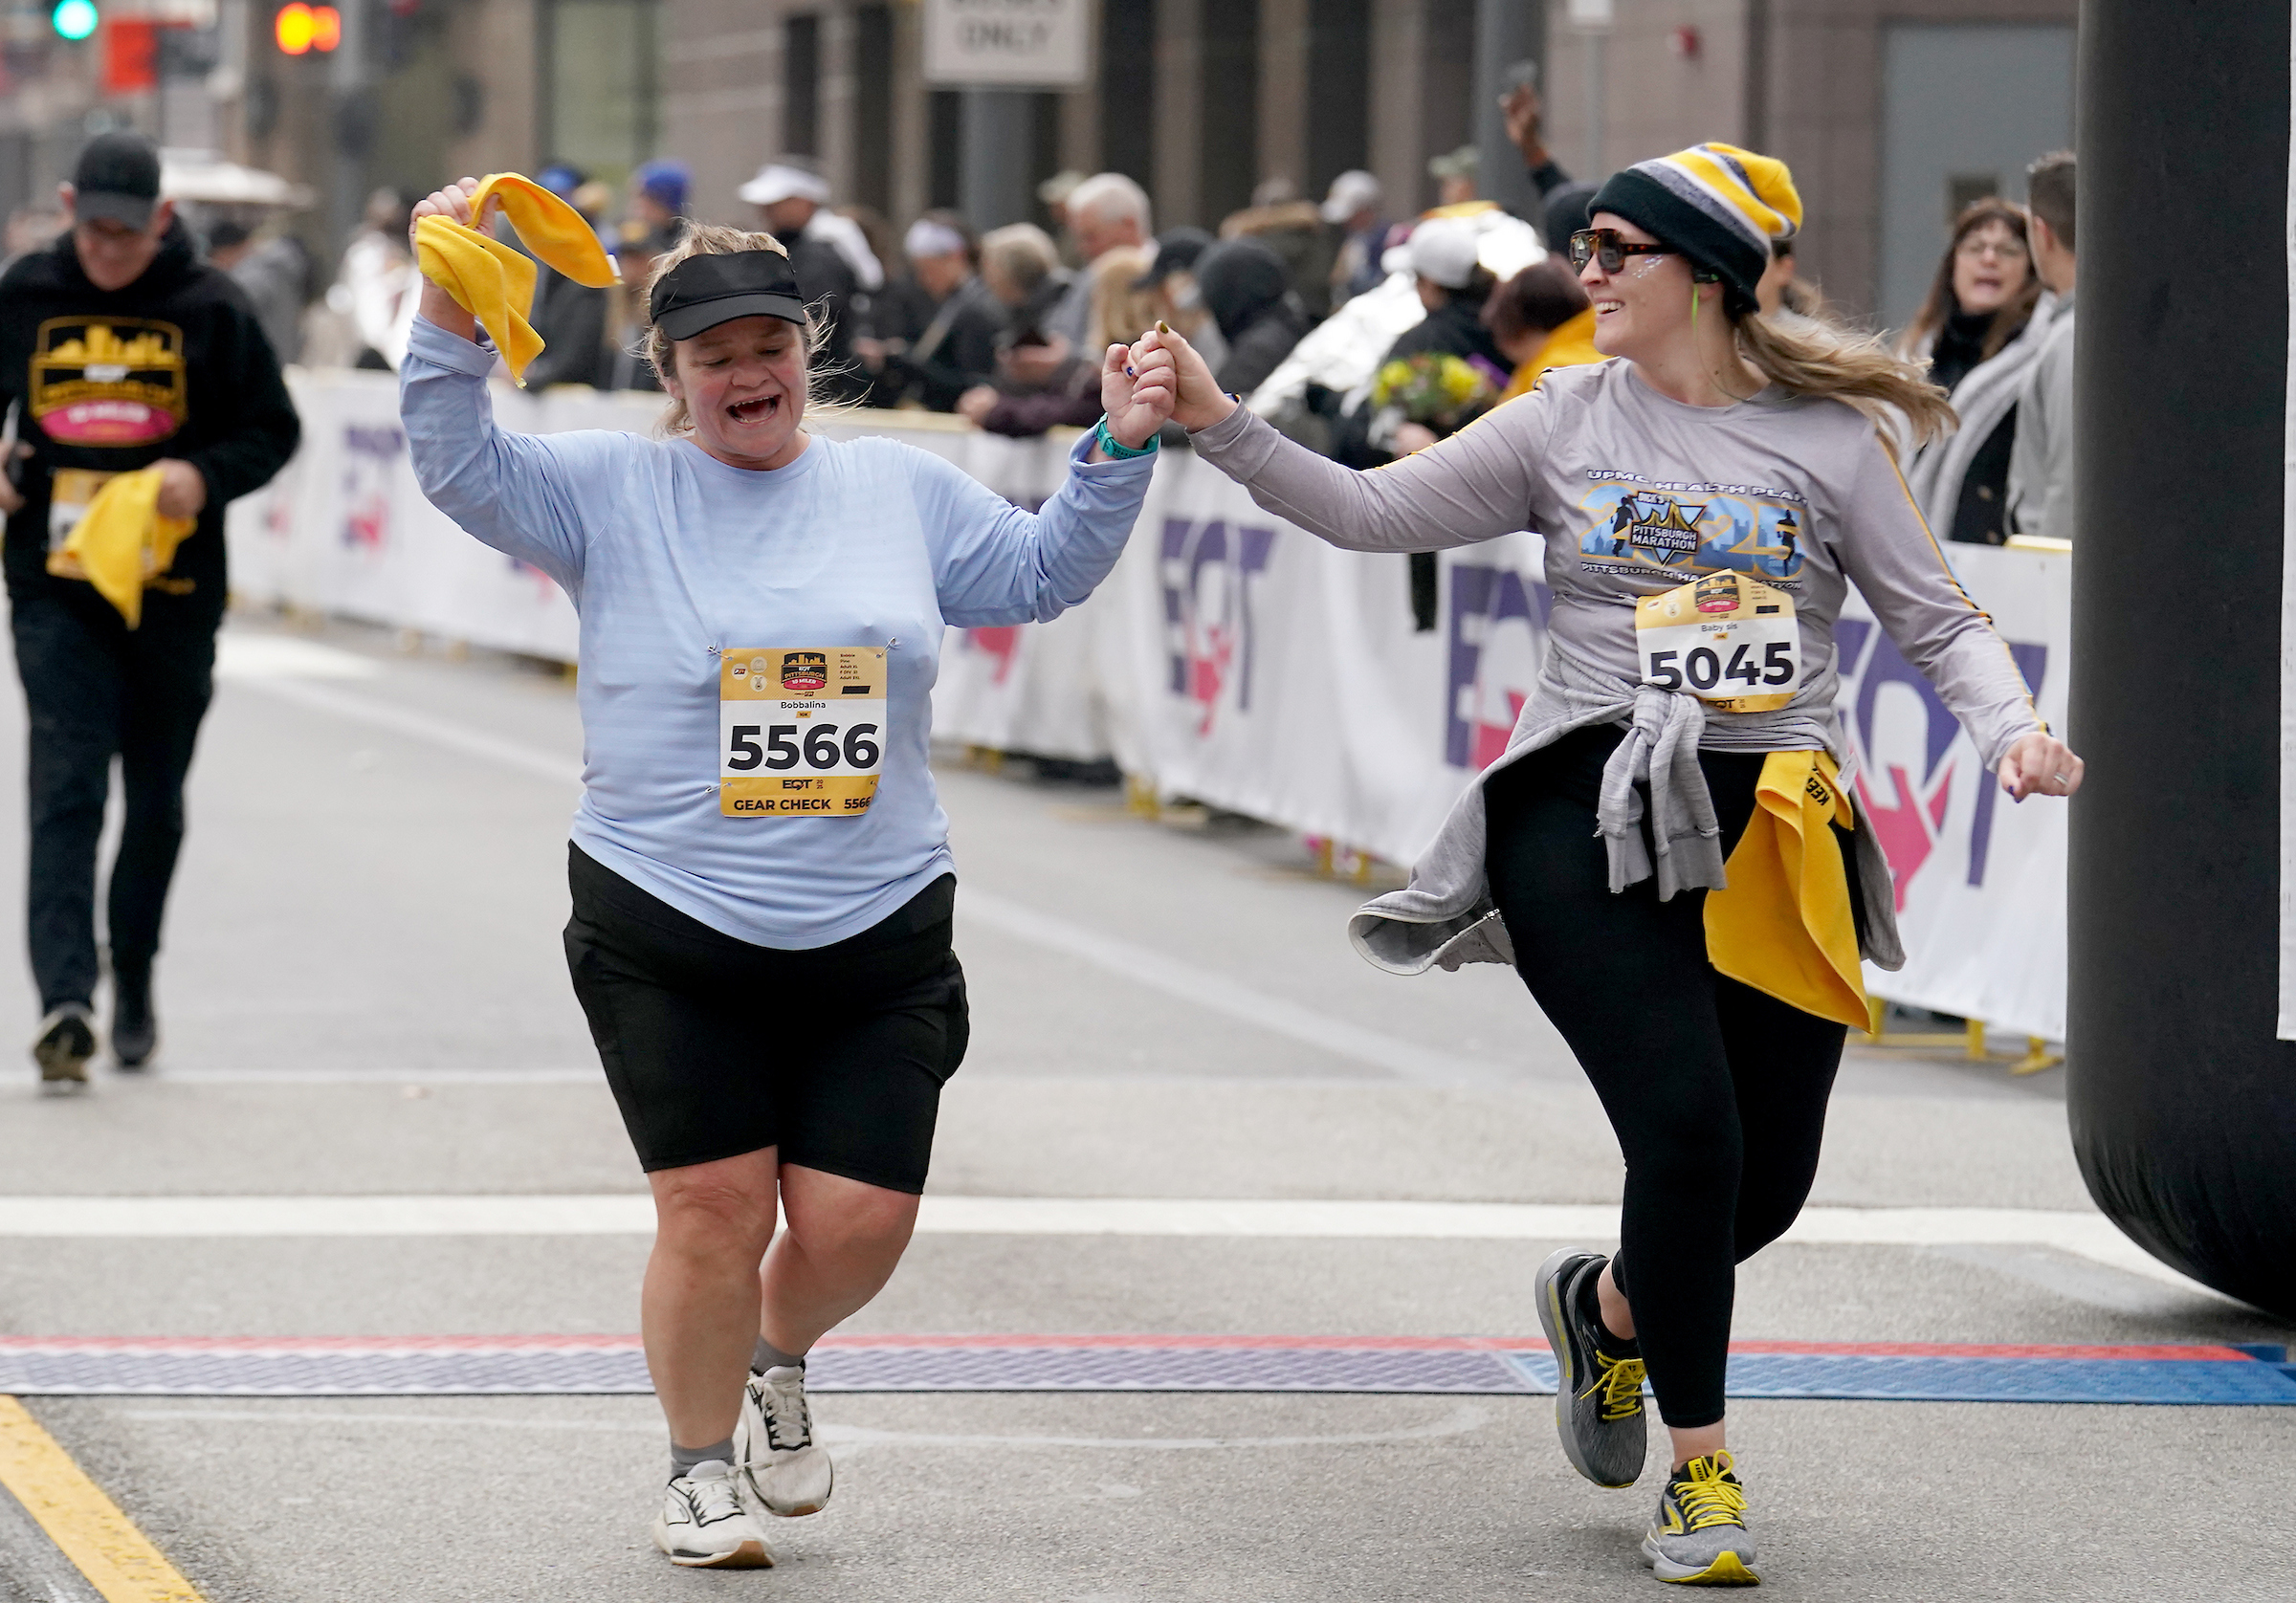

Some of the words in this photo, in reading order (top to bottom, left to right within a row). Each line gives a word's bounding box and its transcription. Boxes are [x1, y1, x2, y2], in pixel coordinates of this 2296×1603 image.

[1587, 470, 1652, 484] UPMC
[1654, 480, 1747, 495] HEALTH
[1632, 524, 1698, 541] PITTSBURGH
[1632, 534, 1697, 552] MARATHON
[1677, 570, 1702, 582] HA
[1726, 623, 1738, 631] sis
[1446, 563, 1554, 771] EQ
[1650, 642, 1794, 691] 5045
[1707, 698, 1735, 709] QT
[727, 723, 879, 771] 5566
[783, 780, 813, 791] EQT
[1805, 776, 1830, 805] KEE
[734, 800, 776, 811] GEAR
[780, 799, 831, 810] CHECK
[844, 797, 872, 810] 5566
